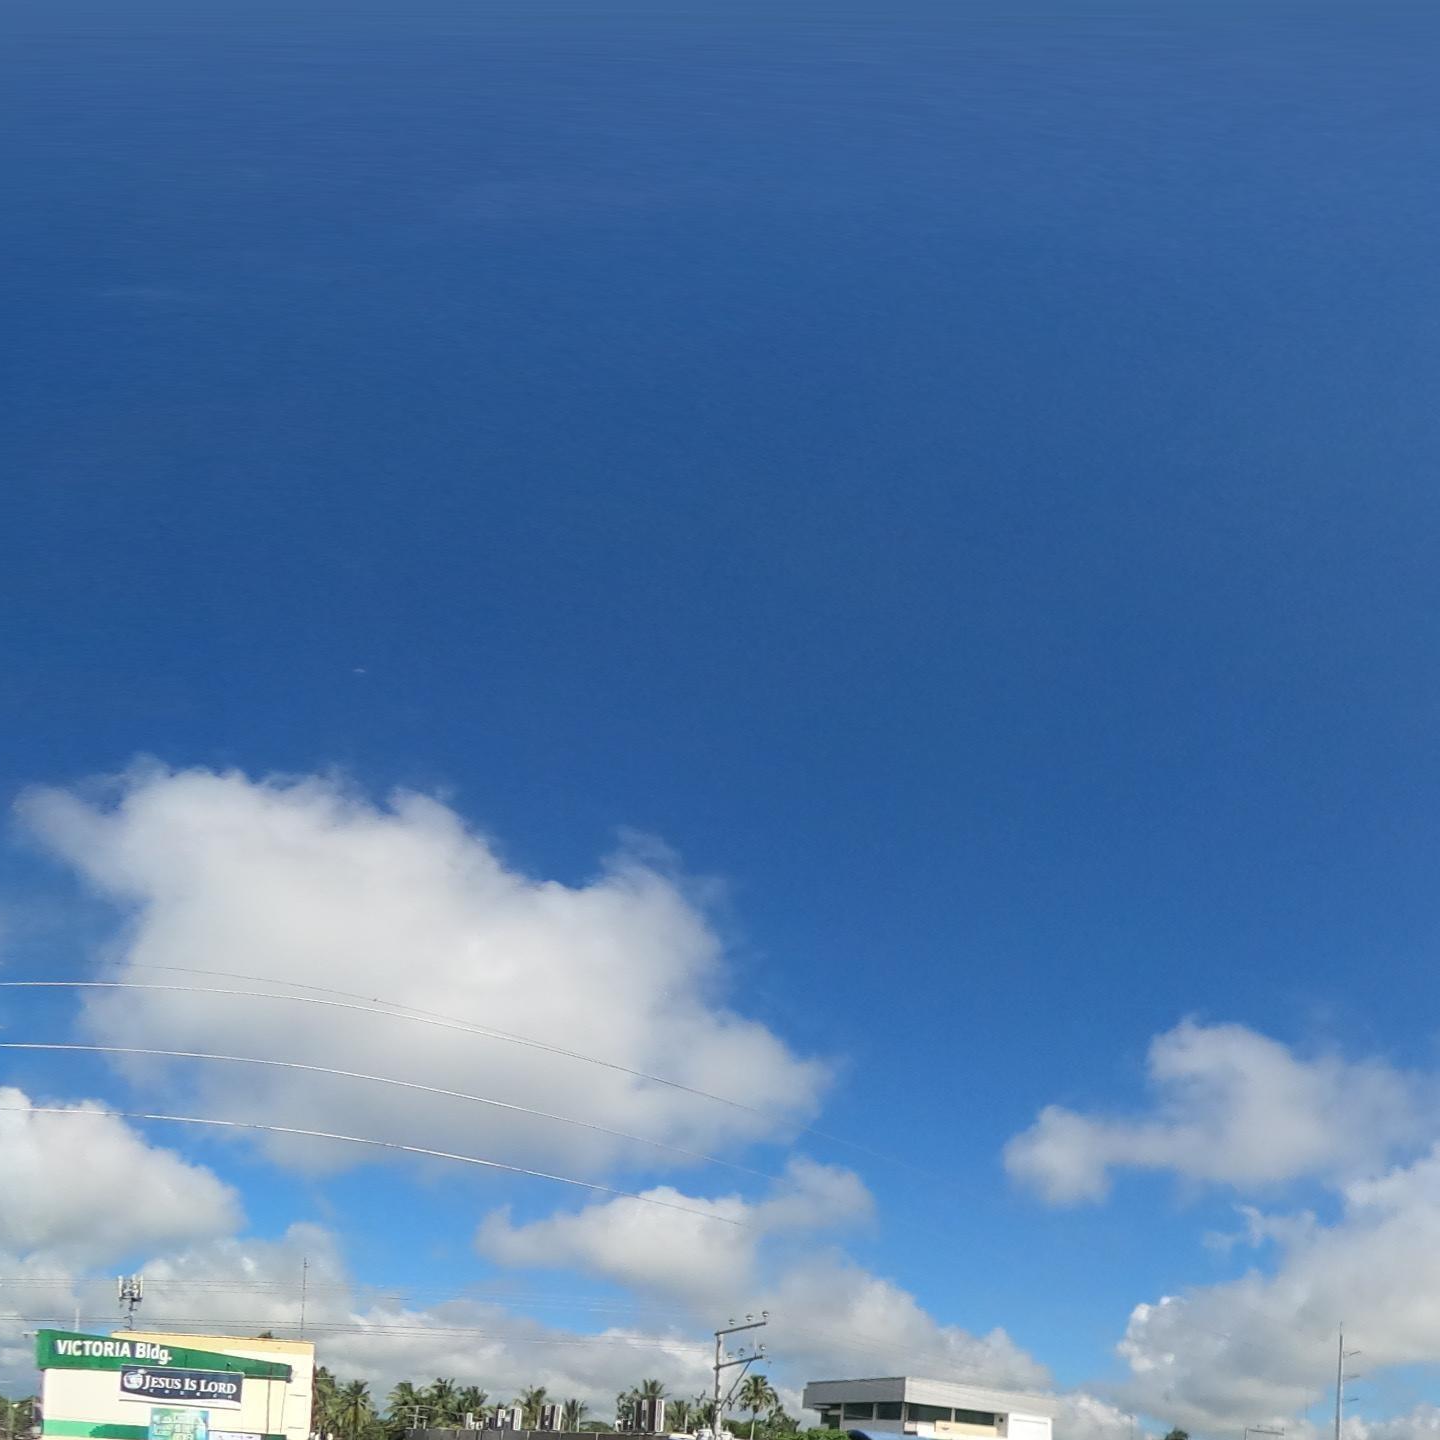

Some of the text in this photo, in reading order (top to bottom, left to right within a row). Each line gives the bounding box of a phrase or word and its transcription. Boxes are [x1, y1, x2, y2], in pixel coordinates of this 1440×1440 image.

[56, 1339, 173, 1365] VICTORIA Bldg.
[142, 1375, 237, 1394] JESUS IS LORD
